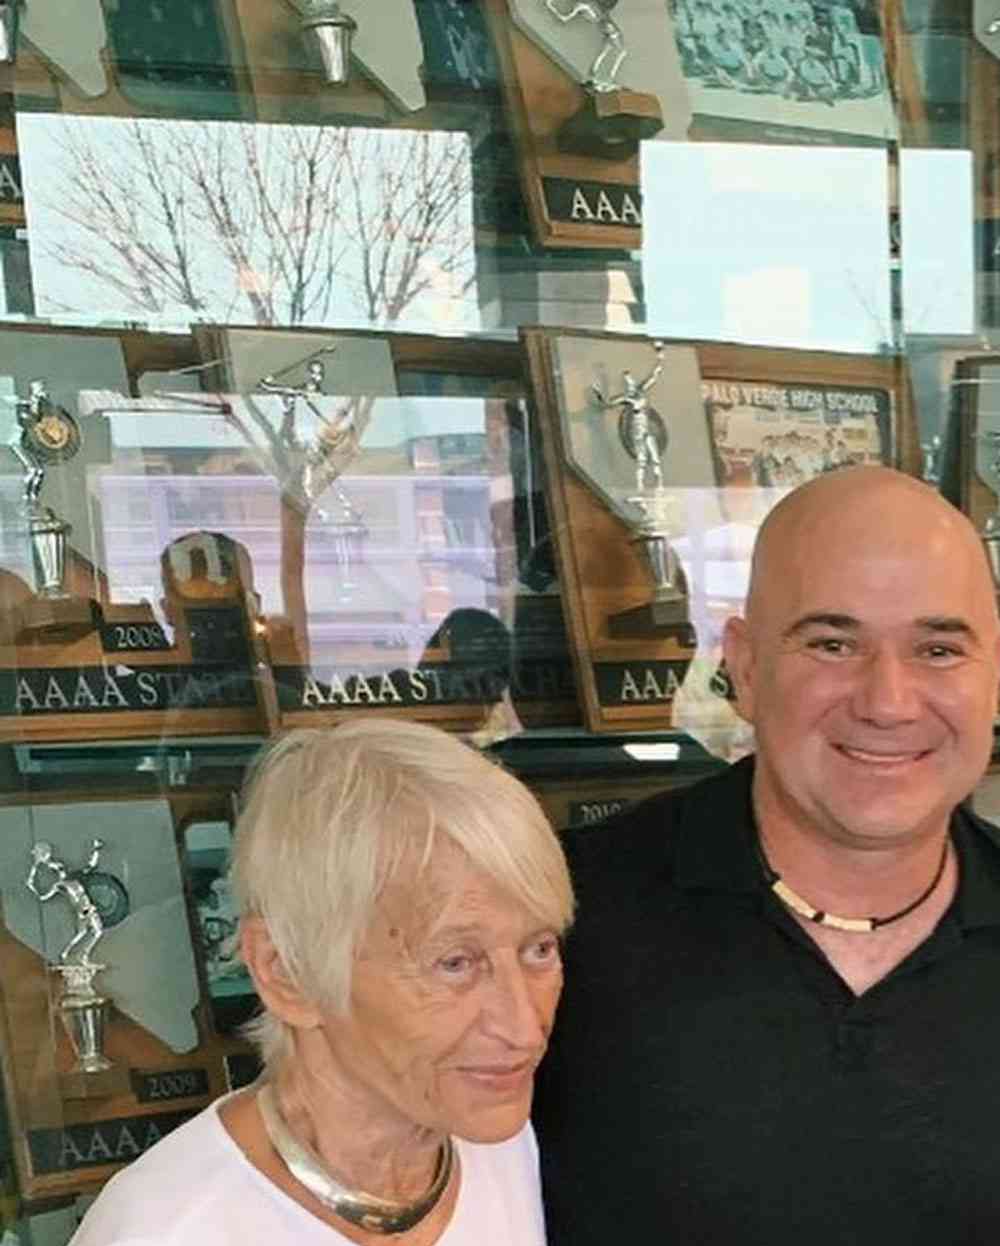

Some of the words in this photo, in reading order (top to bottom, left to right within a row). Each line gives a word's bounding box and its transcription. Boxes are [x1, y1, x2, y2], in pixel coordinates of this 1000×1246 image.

[571, 187, 641, 223] AAA
[15, 670, 128, 710] AAAA
[302, 671, 402, 706] AAAA
[147, 1075, 198, 1098] 2009
